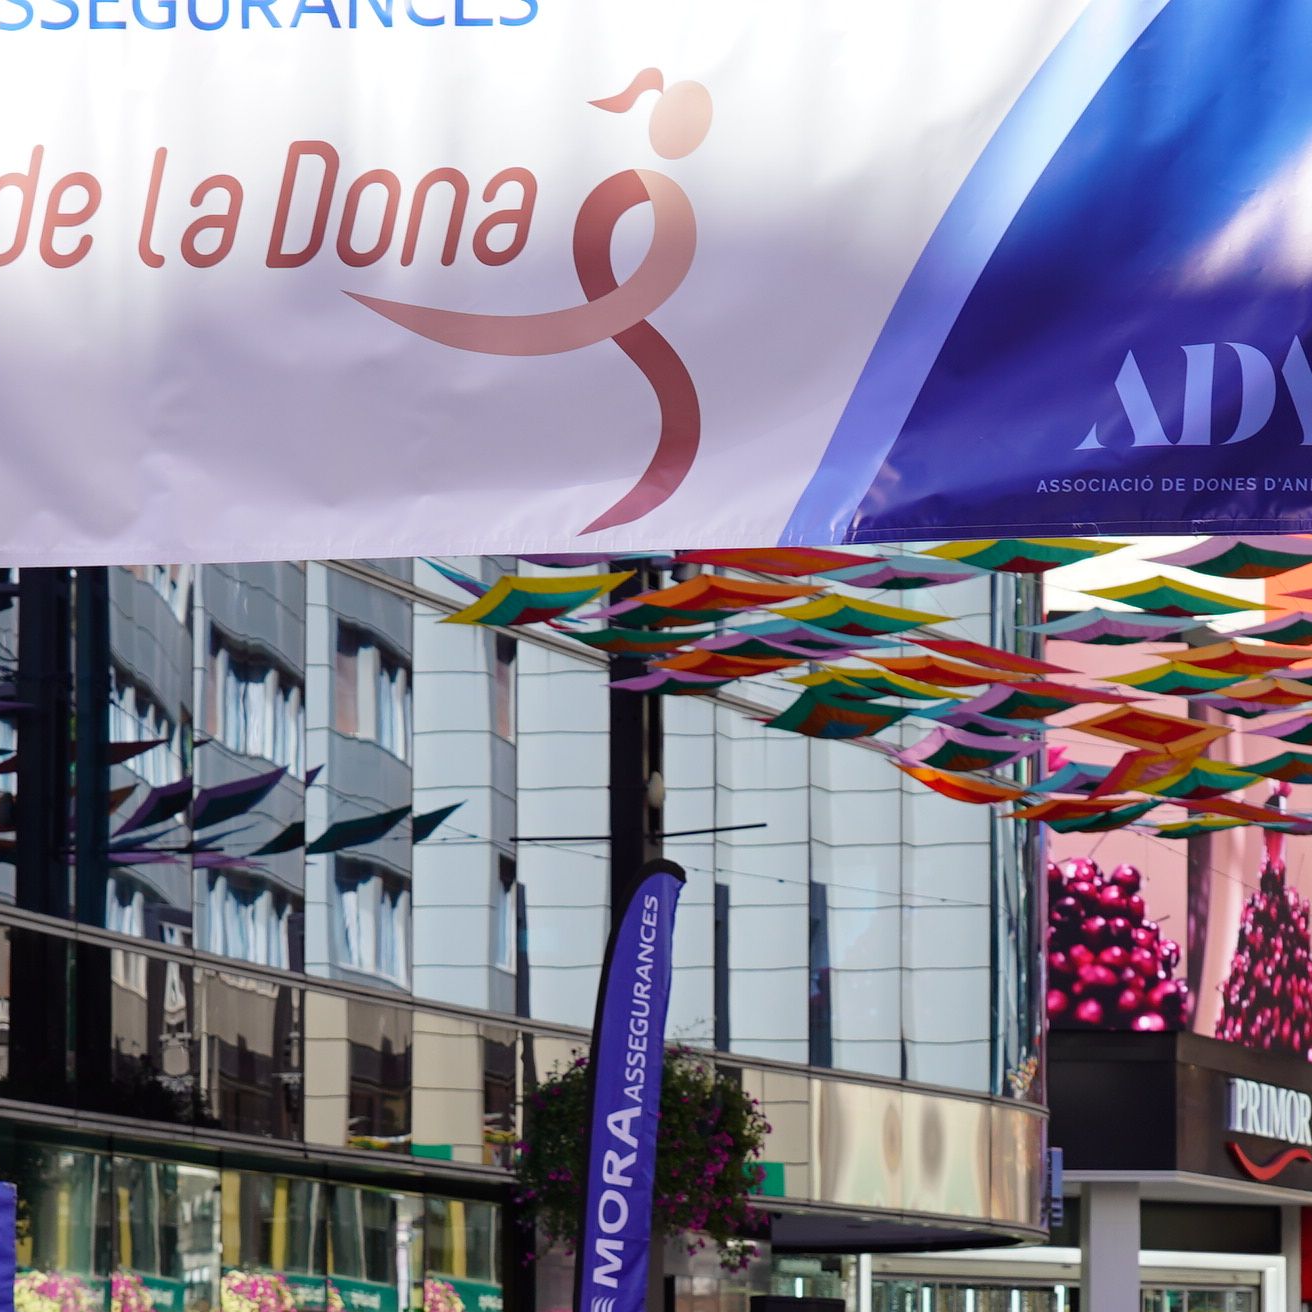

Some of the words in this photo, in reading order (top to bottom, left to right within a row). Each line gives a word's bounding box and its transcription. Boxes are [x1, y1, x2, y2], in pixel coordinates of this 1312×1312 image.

[139, 146, 244, 269] la
[265, 140, 538, 269] Dona
[1037, 475, 1154, 493] ASSOCIACIÓ
[1161, 478, 1185, 492] DE
[1193, 477, 1257, 492] DONES
[623, 894, 658, 1104] ASSEGURANCES
[1229, 1078, 1312, 1147] PRIMOR
[593, 1106, 641, 1289] MORA
